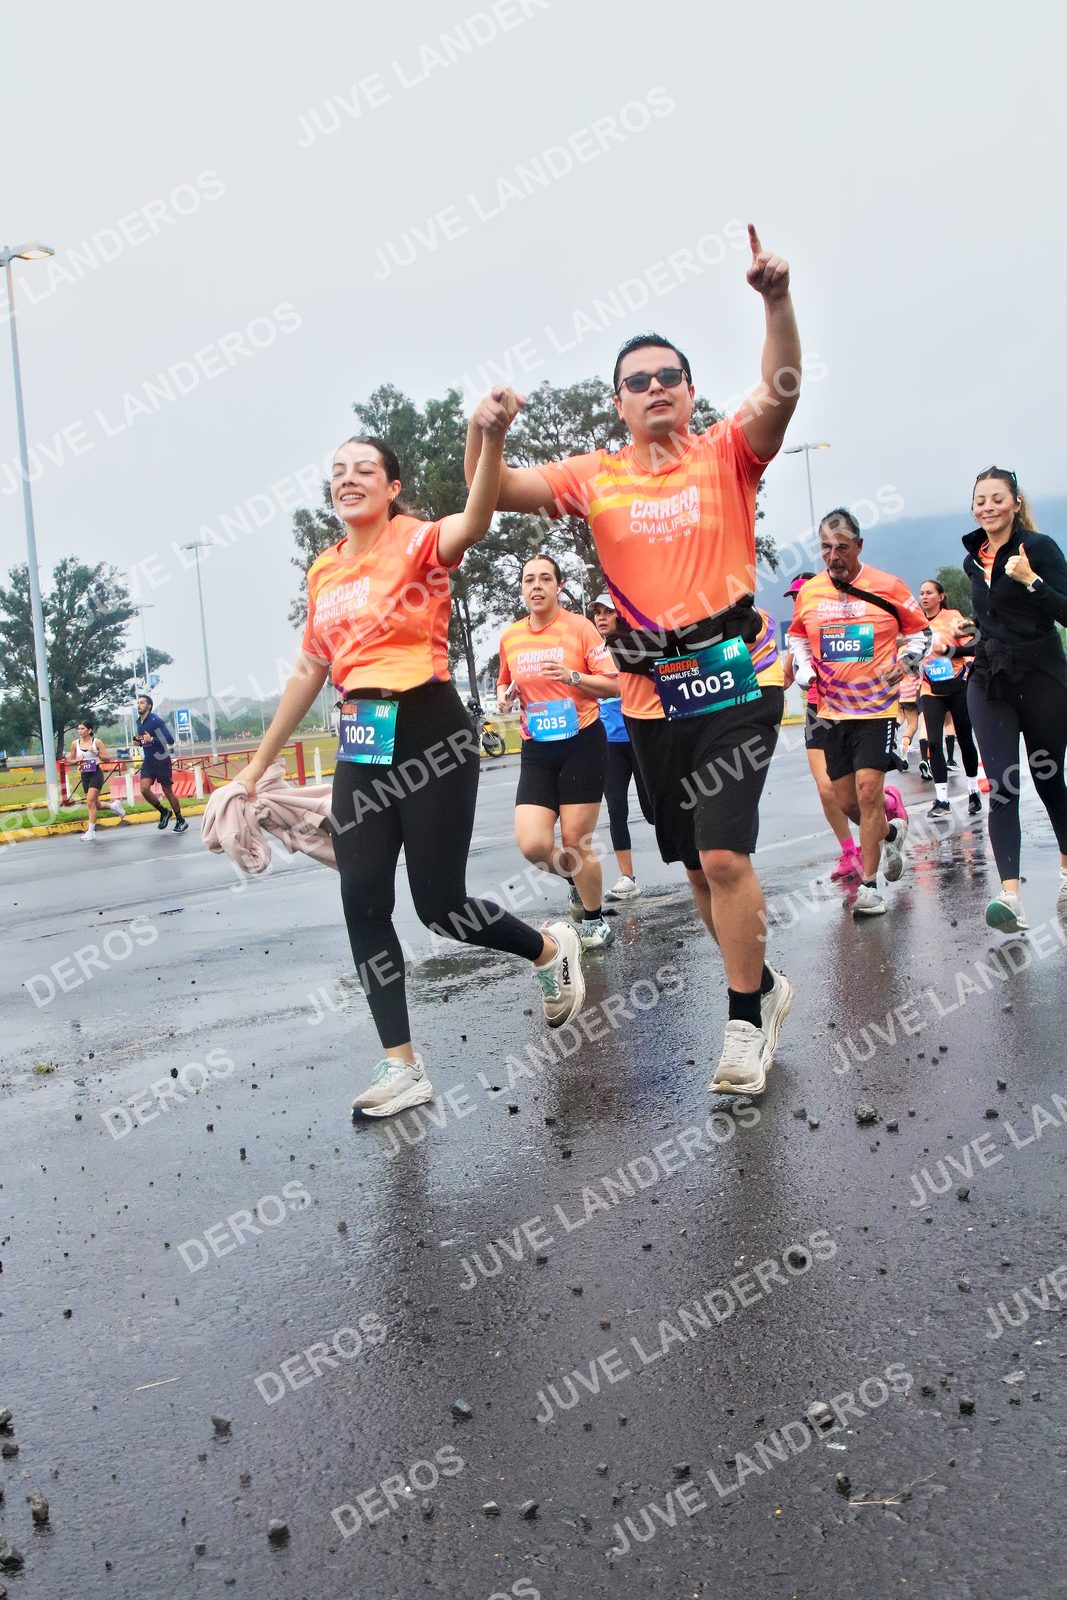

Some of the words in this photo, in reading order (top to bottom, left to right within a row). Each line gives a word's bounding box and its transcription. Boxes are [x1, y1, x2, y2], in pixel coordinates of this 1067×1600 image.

[631, 485, 699, 519] CARRERA
[630, 514, 687, 534] OMNILIFE
[313, 602, 354, 626] OMNILIFE
[722, 643, 740, 661] 10K
[829, 640, 861, 652] 1065
[658, 658, 698, 675] CARRERA
[660, 671, 691, 682] OMNILIFE
[677, 671, 735, 700] 1003
[374, 704, 391, 718] 10K
[536, 716, 566, 730] 2035
[344, 725, 375, 746] 1002
[562, 957, 572, 985] HOKA
